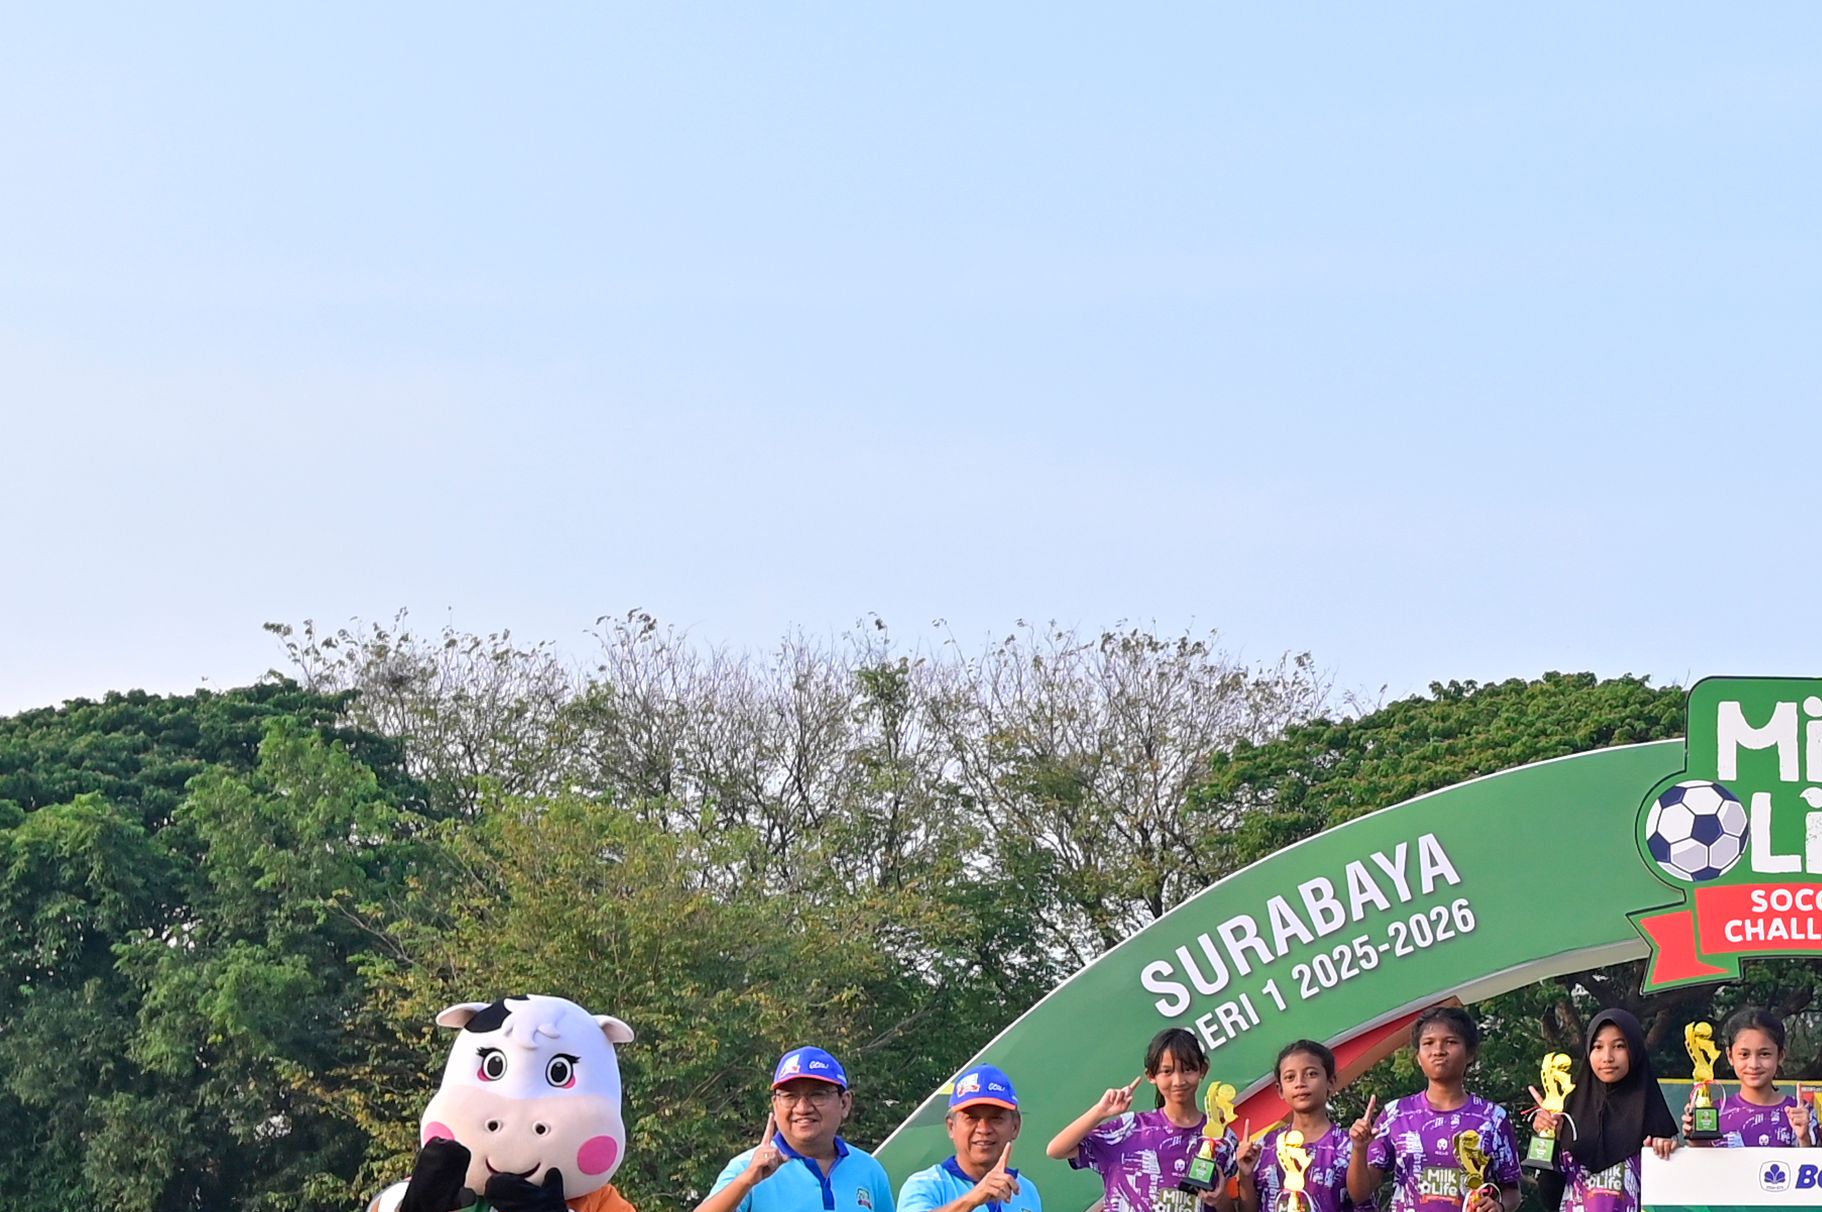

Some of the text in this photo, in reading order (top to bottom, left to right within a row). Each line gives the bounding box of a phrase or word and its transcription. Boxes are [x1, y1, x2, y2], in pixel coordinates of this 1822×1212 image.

[1139, 832, 1462, 1018] SURABAYA
[1261, 978, 1287, 1011] 1
[1291, 897, 1477, 1000] 2025-2026
[1427, 1168, 1457, 1184] Milk
[1596, 1175, 1622, 1190] Life
[1431, 1181, 1458, 1197] Life
[1162, 1190, 1192, 1206] Milk
